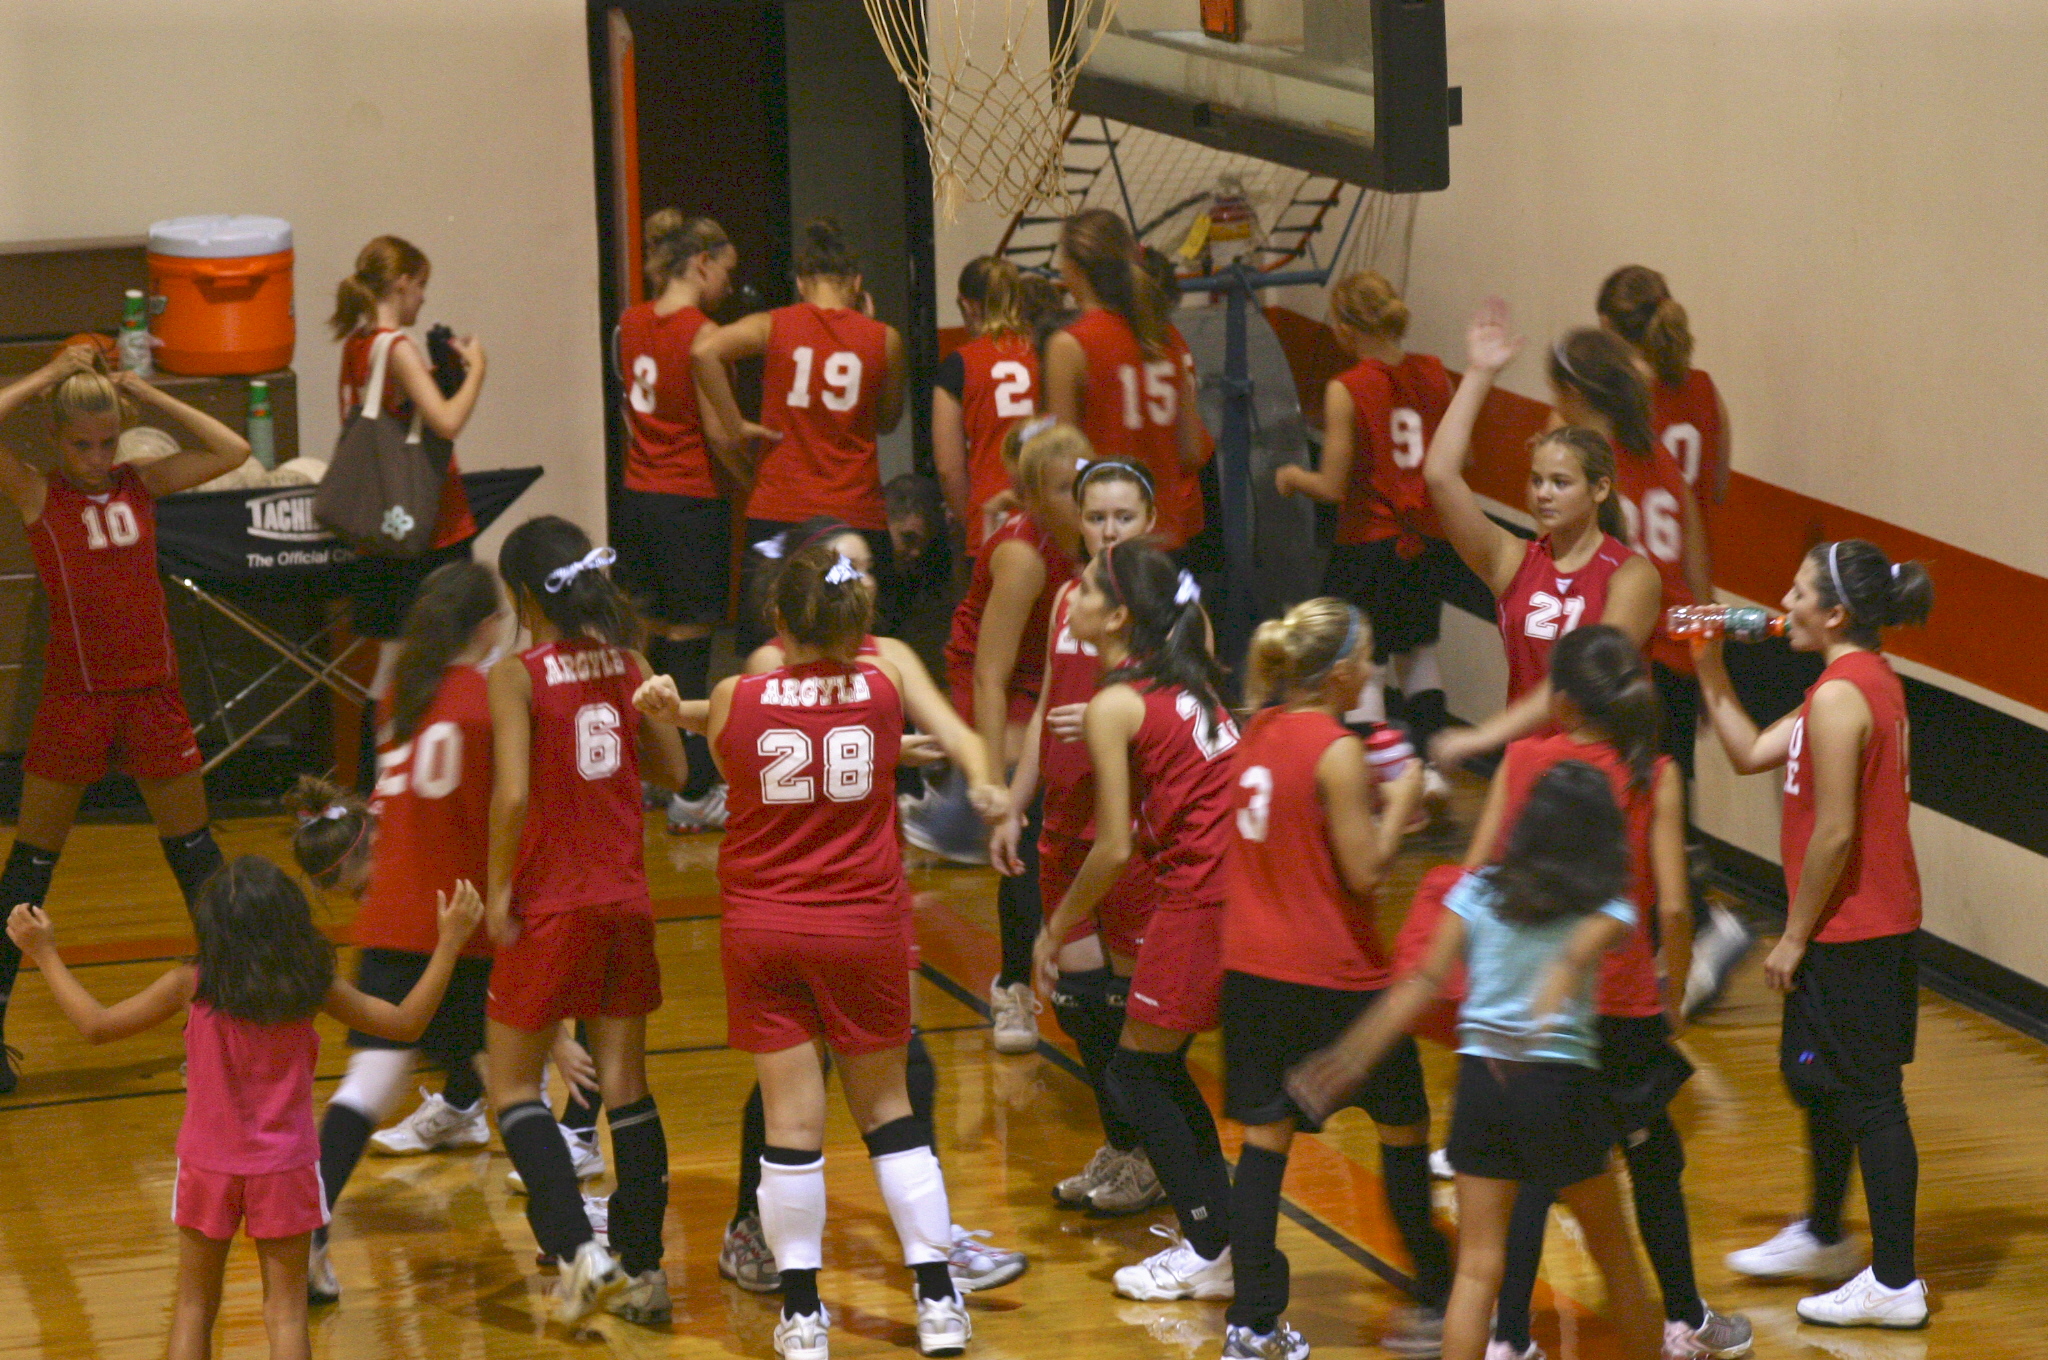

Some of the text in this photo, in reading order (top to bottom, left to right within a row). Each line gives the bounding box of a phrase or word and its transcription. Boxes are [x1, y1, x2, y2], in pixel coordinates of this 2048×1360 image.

[786, 346, 863, 412] 19
[990, 360, 1034, 418] 2
[1118, 360, 1177, 430] 15
[1390, 407, 1424, 470] 9
[81, 501, 140, 550] 10
[246, 553, 274, 568] The
[277, 550, 328, 566] Official
[543, 647, 626, 687] ARGYLE
[760, 673, 871, 707] ARGYLE
[575, 702, 621, 781] 6
[757, 725, 874, 804] 28
[1236, 765, 1273, 843] 3
